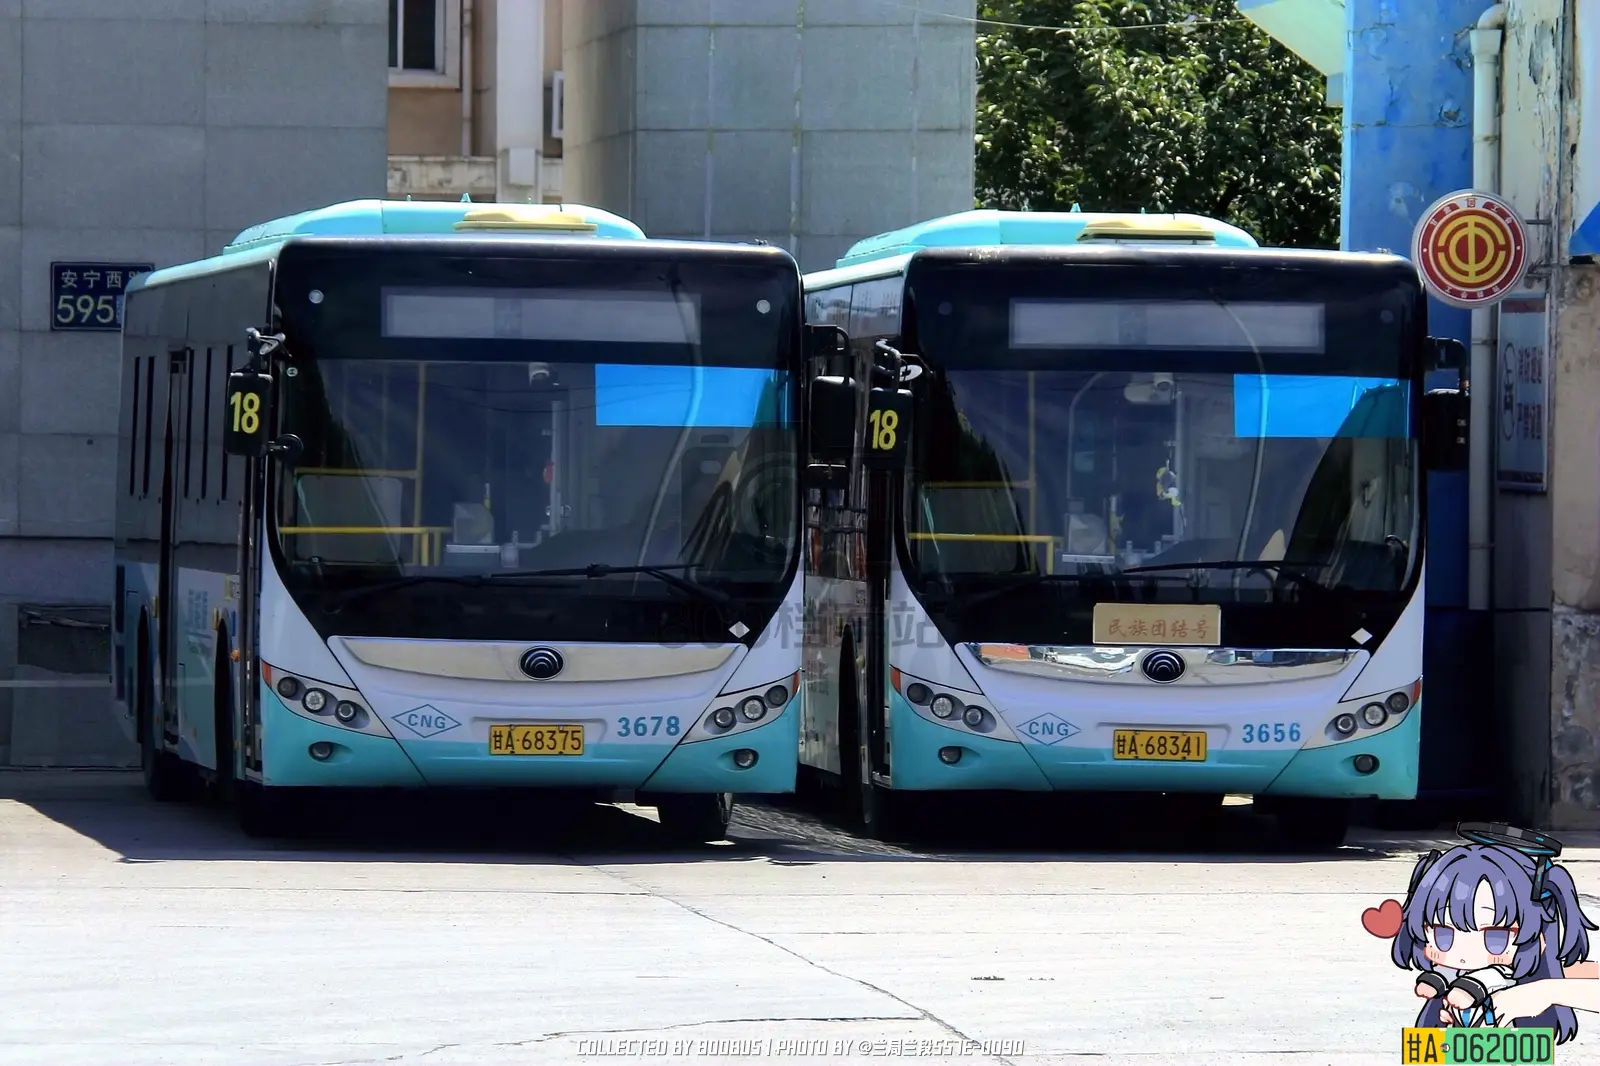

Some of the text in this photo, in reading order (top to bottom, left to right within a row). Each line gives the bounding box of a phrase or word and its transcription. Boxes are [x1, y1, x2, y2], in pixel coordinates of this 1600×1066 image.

[61, 270, 139, 289] 安宁西
[57, 294, 115, 323] 595
[230, 391, 260, 434] 18
[869, 409, 899, 451] 18
[1108, 618, 1210, 639] 民族团结号
[407, 713, 447, 729] CNG
[616, 716, 681, 738] 3678
[1028, 721, 1070, 737] CNG
[492, 729, 582, 751] 甘A·68375
[1242, 723, 1302, 744] 3656
[1116, 734, 1202, 757] 甘A·68341
